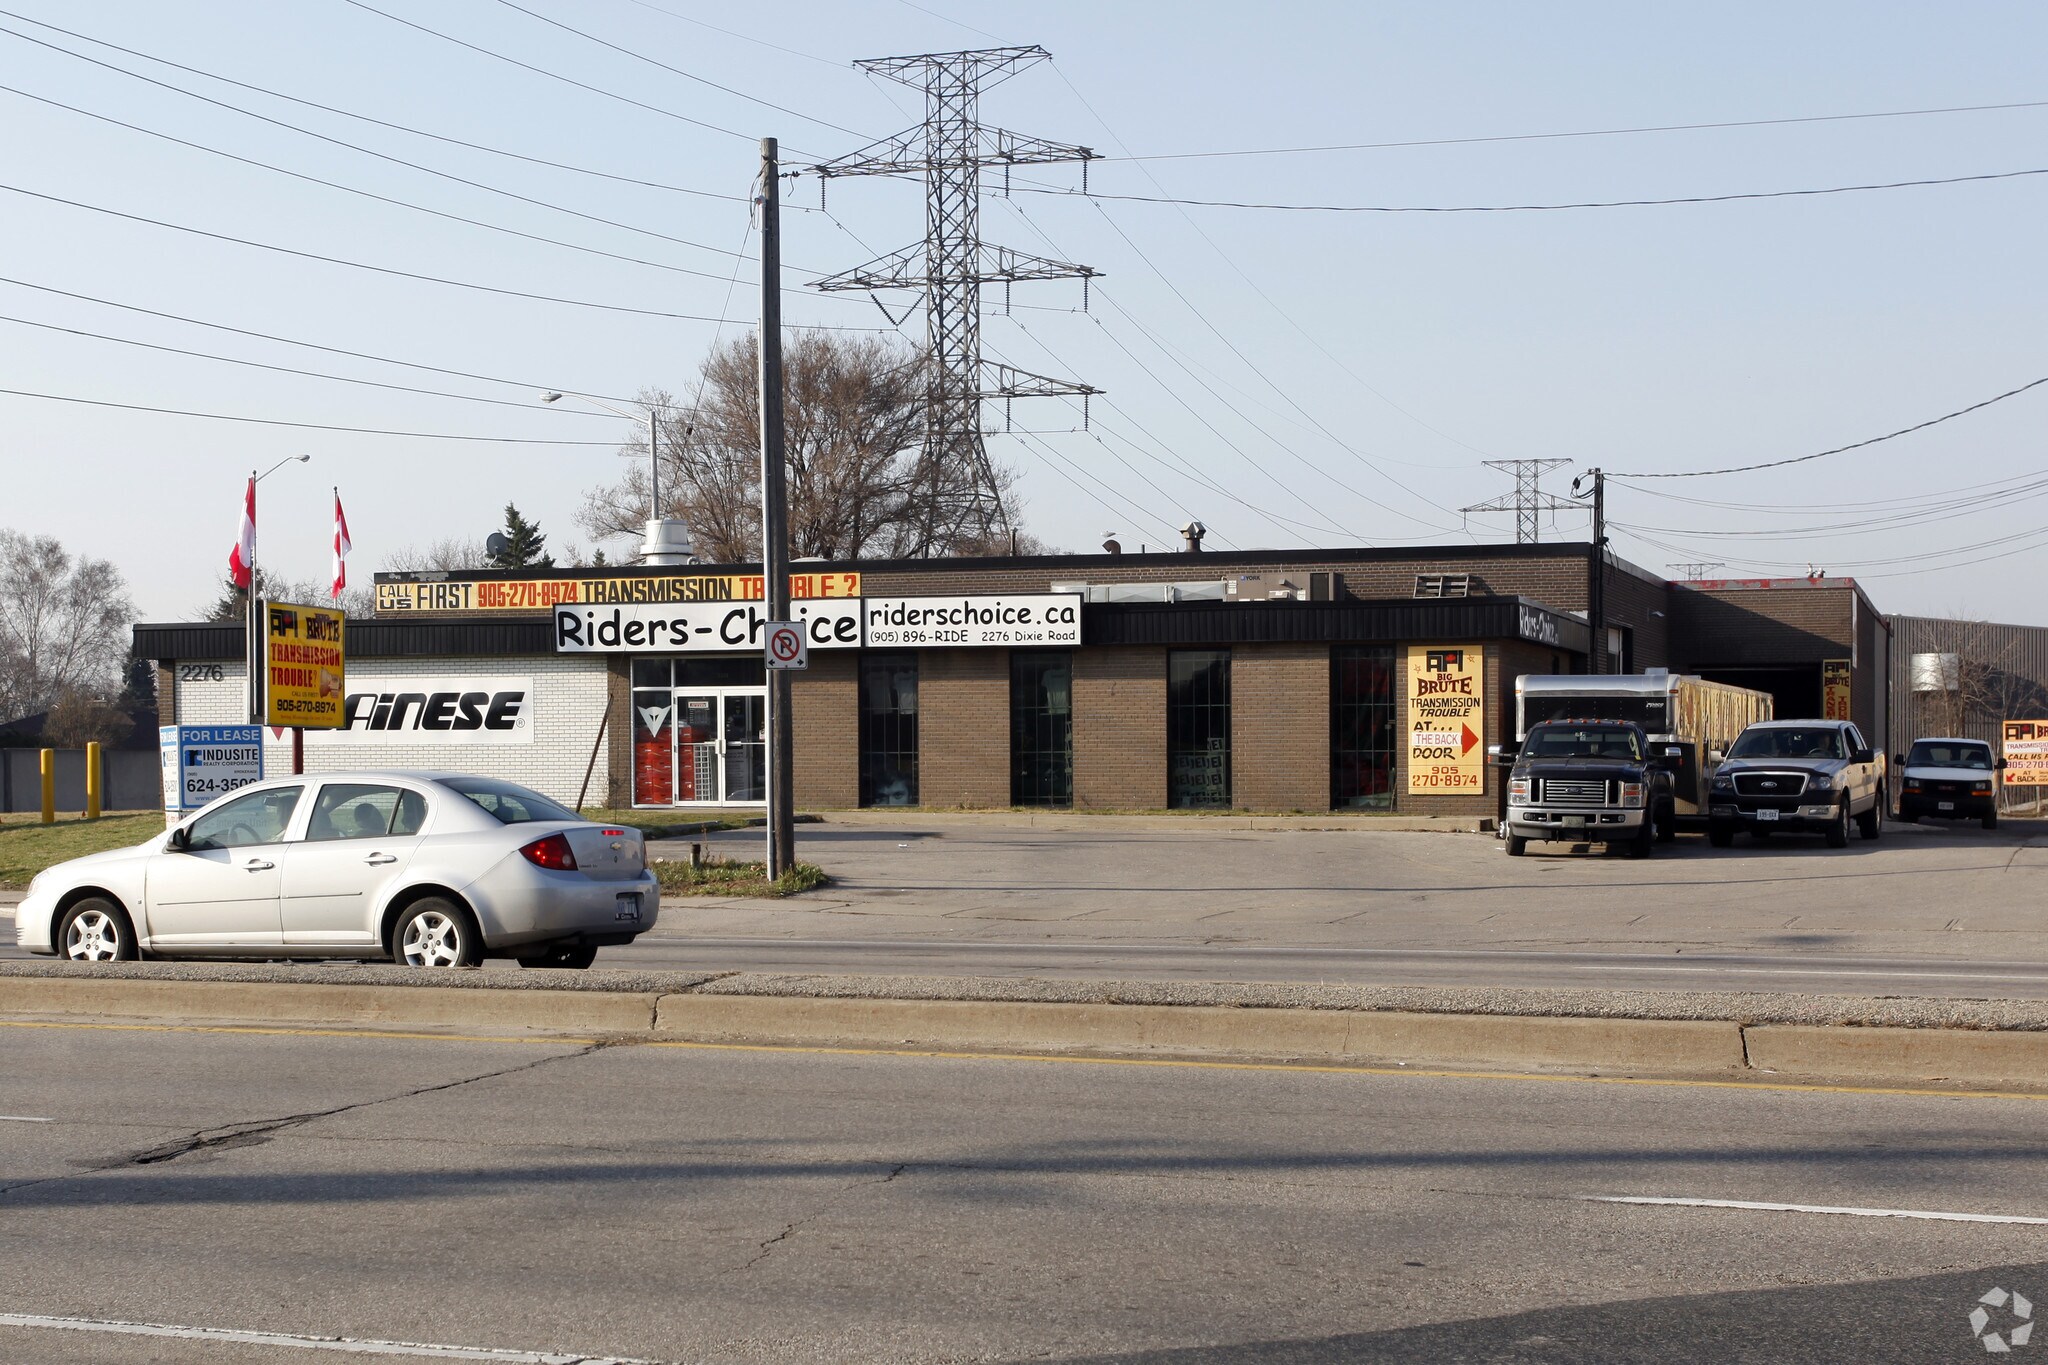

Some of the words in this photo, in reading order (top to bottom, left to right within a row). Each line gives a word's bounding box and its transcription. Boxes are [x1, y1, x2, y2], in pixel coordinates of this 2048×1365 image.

[380, 585, 411, 598] CALL
[417, 583, 472, 609] FIRST
[582, 577, 731, 603] TRANSMISSION
[739, 575, 857, 598] TRBLE?
[380, 598, 411, 609] US
[870, 601, 1076, 627] riderschoice.ca
[306, 617, 340, 642] BRUTE
[558, 606, 858, 647] Riders-Chce
[870, 630, 899, 643] (905)
[902, 629, 969, 643] 896-RIDE
[981, 631, 1010, 642] 2276
[1015, 630, 1043, 641] Dixie
[1048, 630, 1076, 641] Road
[270, 643, 340, 667] TRANSMISSION
[180, 665, 223, 682] 2276
[271, 667, 317, 688] TROUBLE?
[1437, 673, 1453, 681] BIG
[1417, 676, 1472, 697] BRUTE
[1410, 697, 1480, 708] TRANSMISSION
[1419, 708, 1470, 717] TROUBLE
[181, 730, 210, 742] FOR
[215, 729, 260, 741] LEASE
[1416, 733, 1433, 745] THE
[1434, 733, 1458, 745] BACK
[202, 748, 258, 761] INDUSITE
[1413, 747, 1456, 760] DOOR
[1431, 766, 1459, 774] 905
